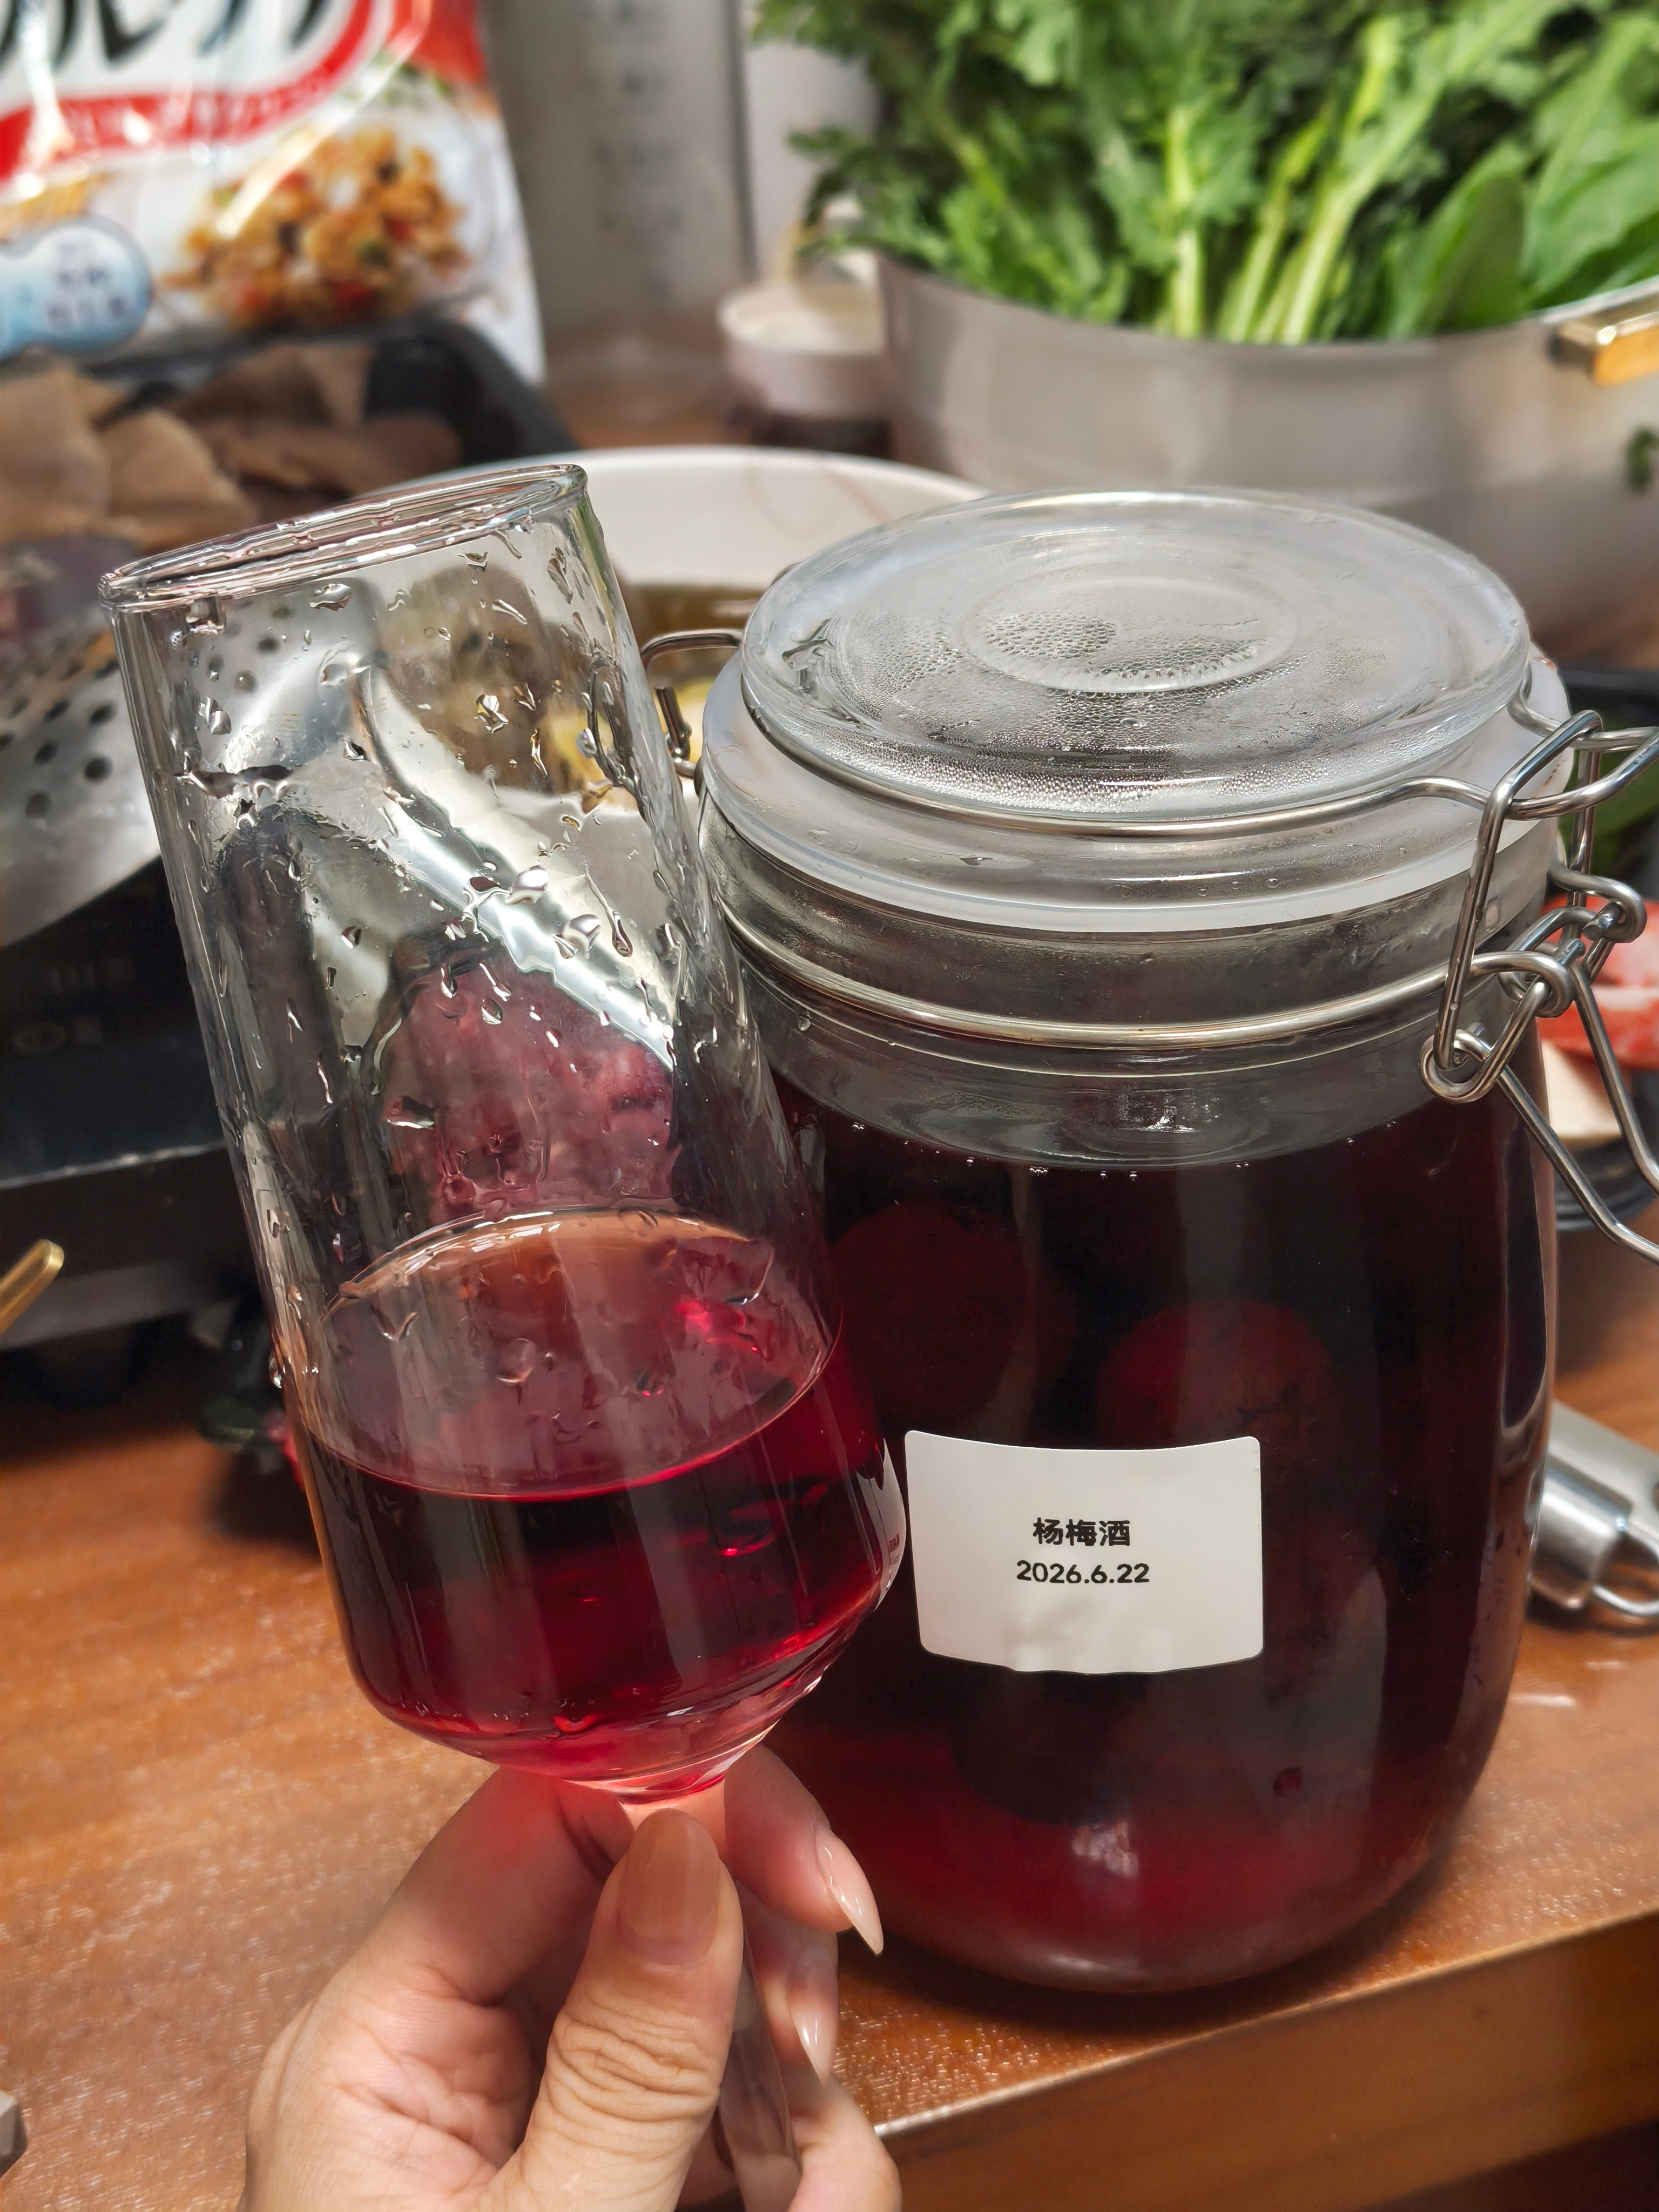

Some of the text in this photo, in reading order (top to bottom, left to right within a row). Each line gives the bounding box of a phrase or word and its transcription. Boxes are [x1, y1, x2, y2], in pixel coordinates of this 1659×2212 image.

[1033, 1517, 1130, 1547] 杨梅酒
[1016, 1560, 1150, 1584] 2026.6.22
